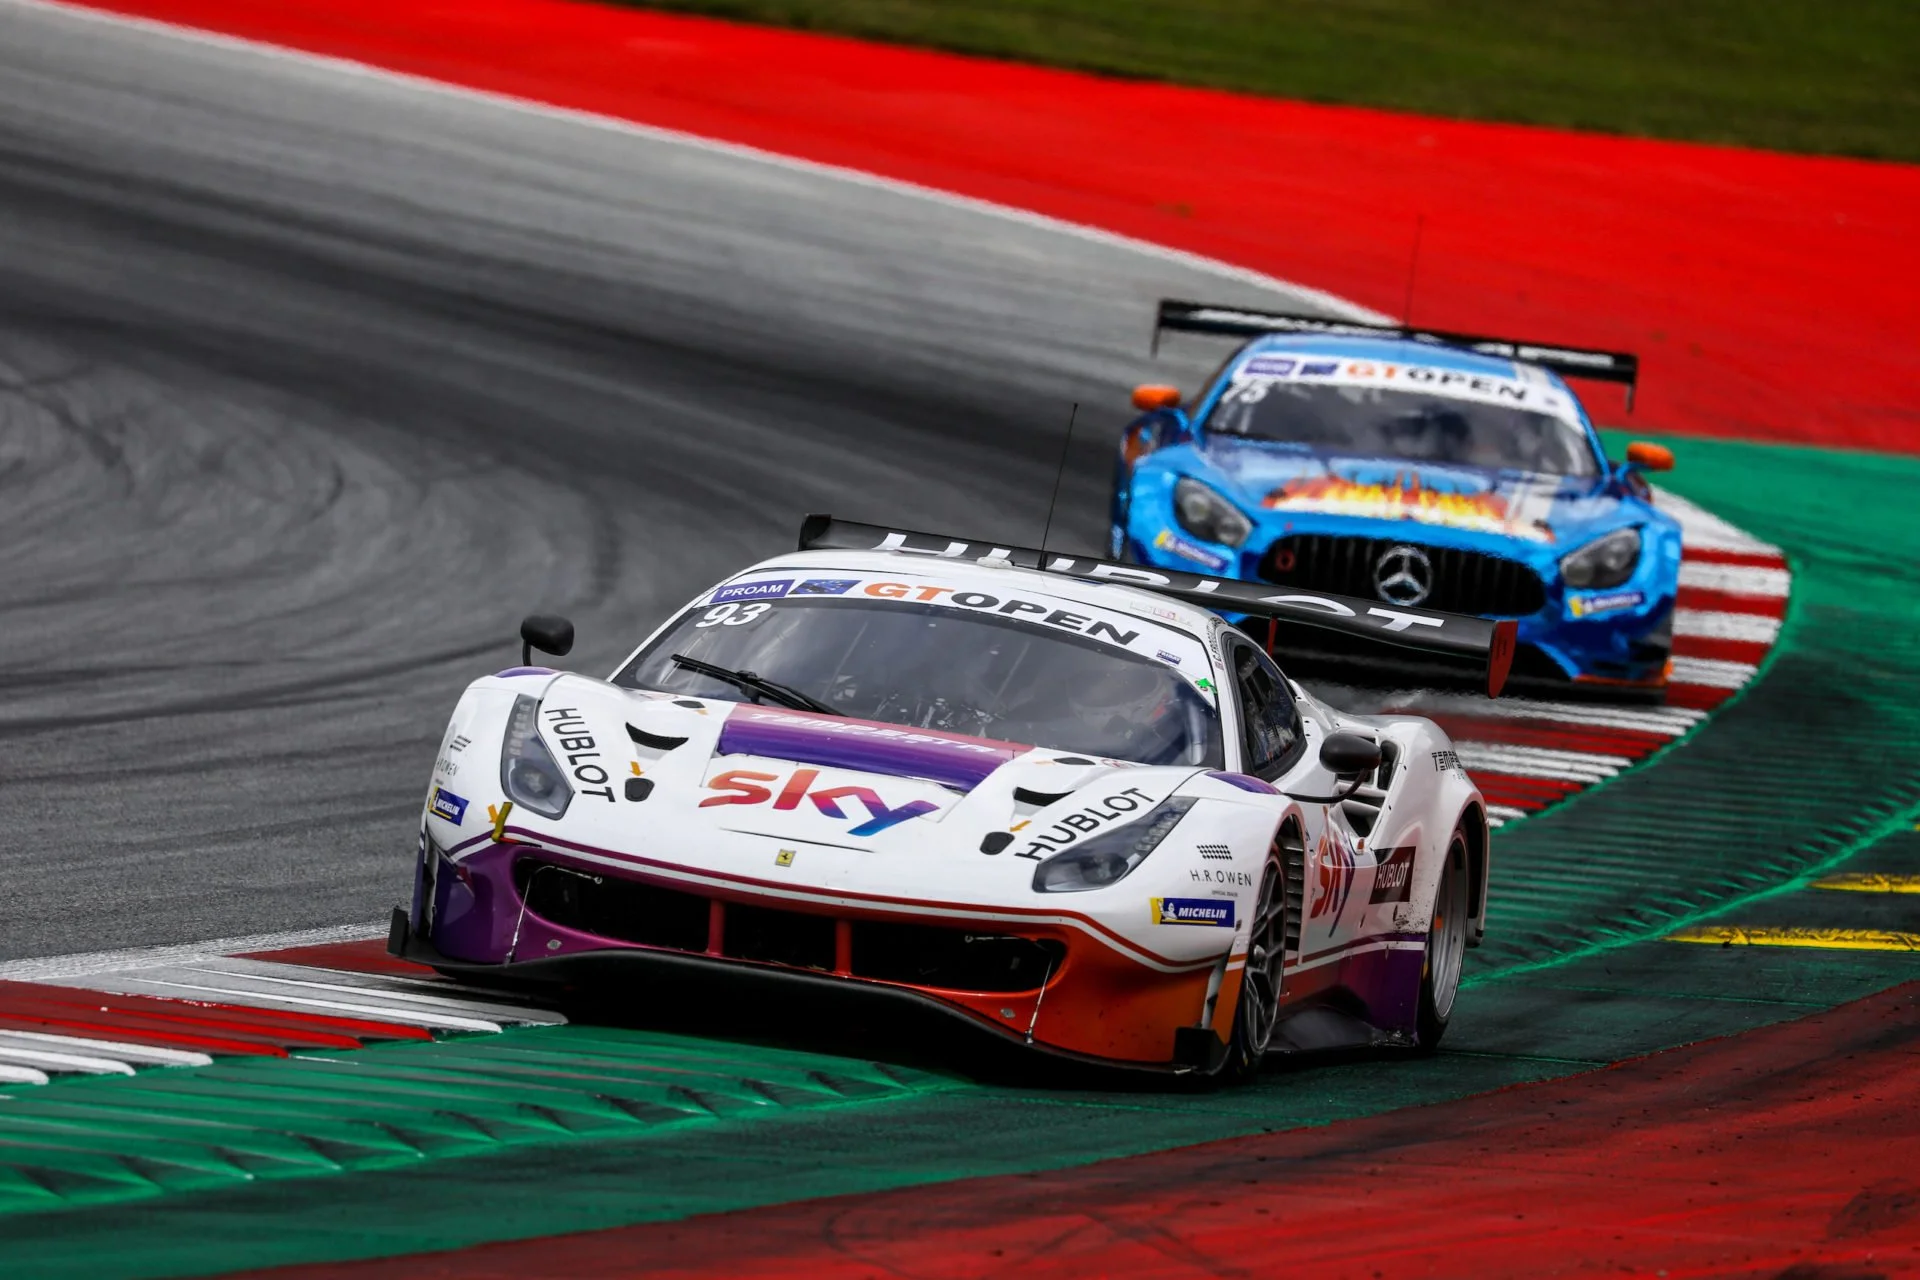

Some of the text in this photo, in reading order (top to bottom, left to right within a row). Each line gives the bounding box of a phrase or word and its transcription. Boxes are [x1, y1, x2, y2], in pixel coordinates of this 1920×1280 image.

[720, 584, 784, 598] PROAM
[695, 602, 772, 628] 93
[544, 707, 616, 803] HUBLOT
[437, 798, 460, 816] MICHELIN
[699, 769, 940, 837] sky
[1014, 787, 1155, 861] HUBLOT
[1310, 804, 1356, 939] sky
[1374, 861, 1410, 890] HUBLOT
[1178, 907, 1227, 919] MICHELIN
